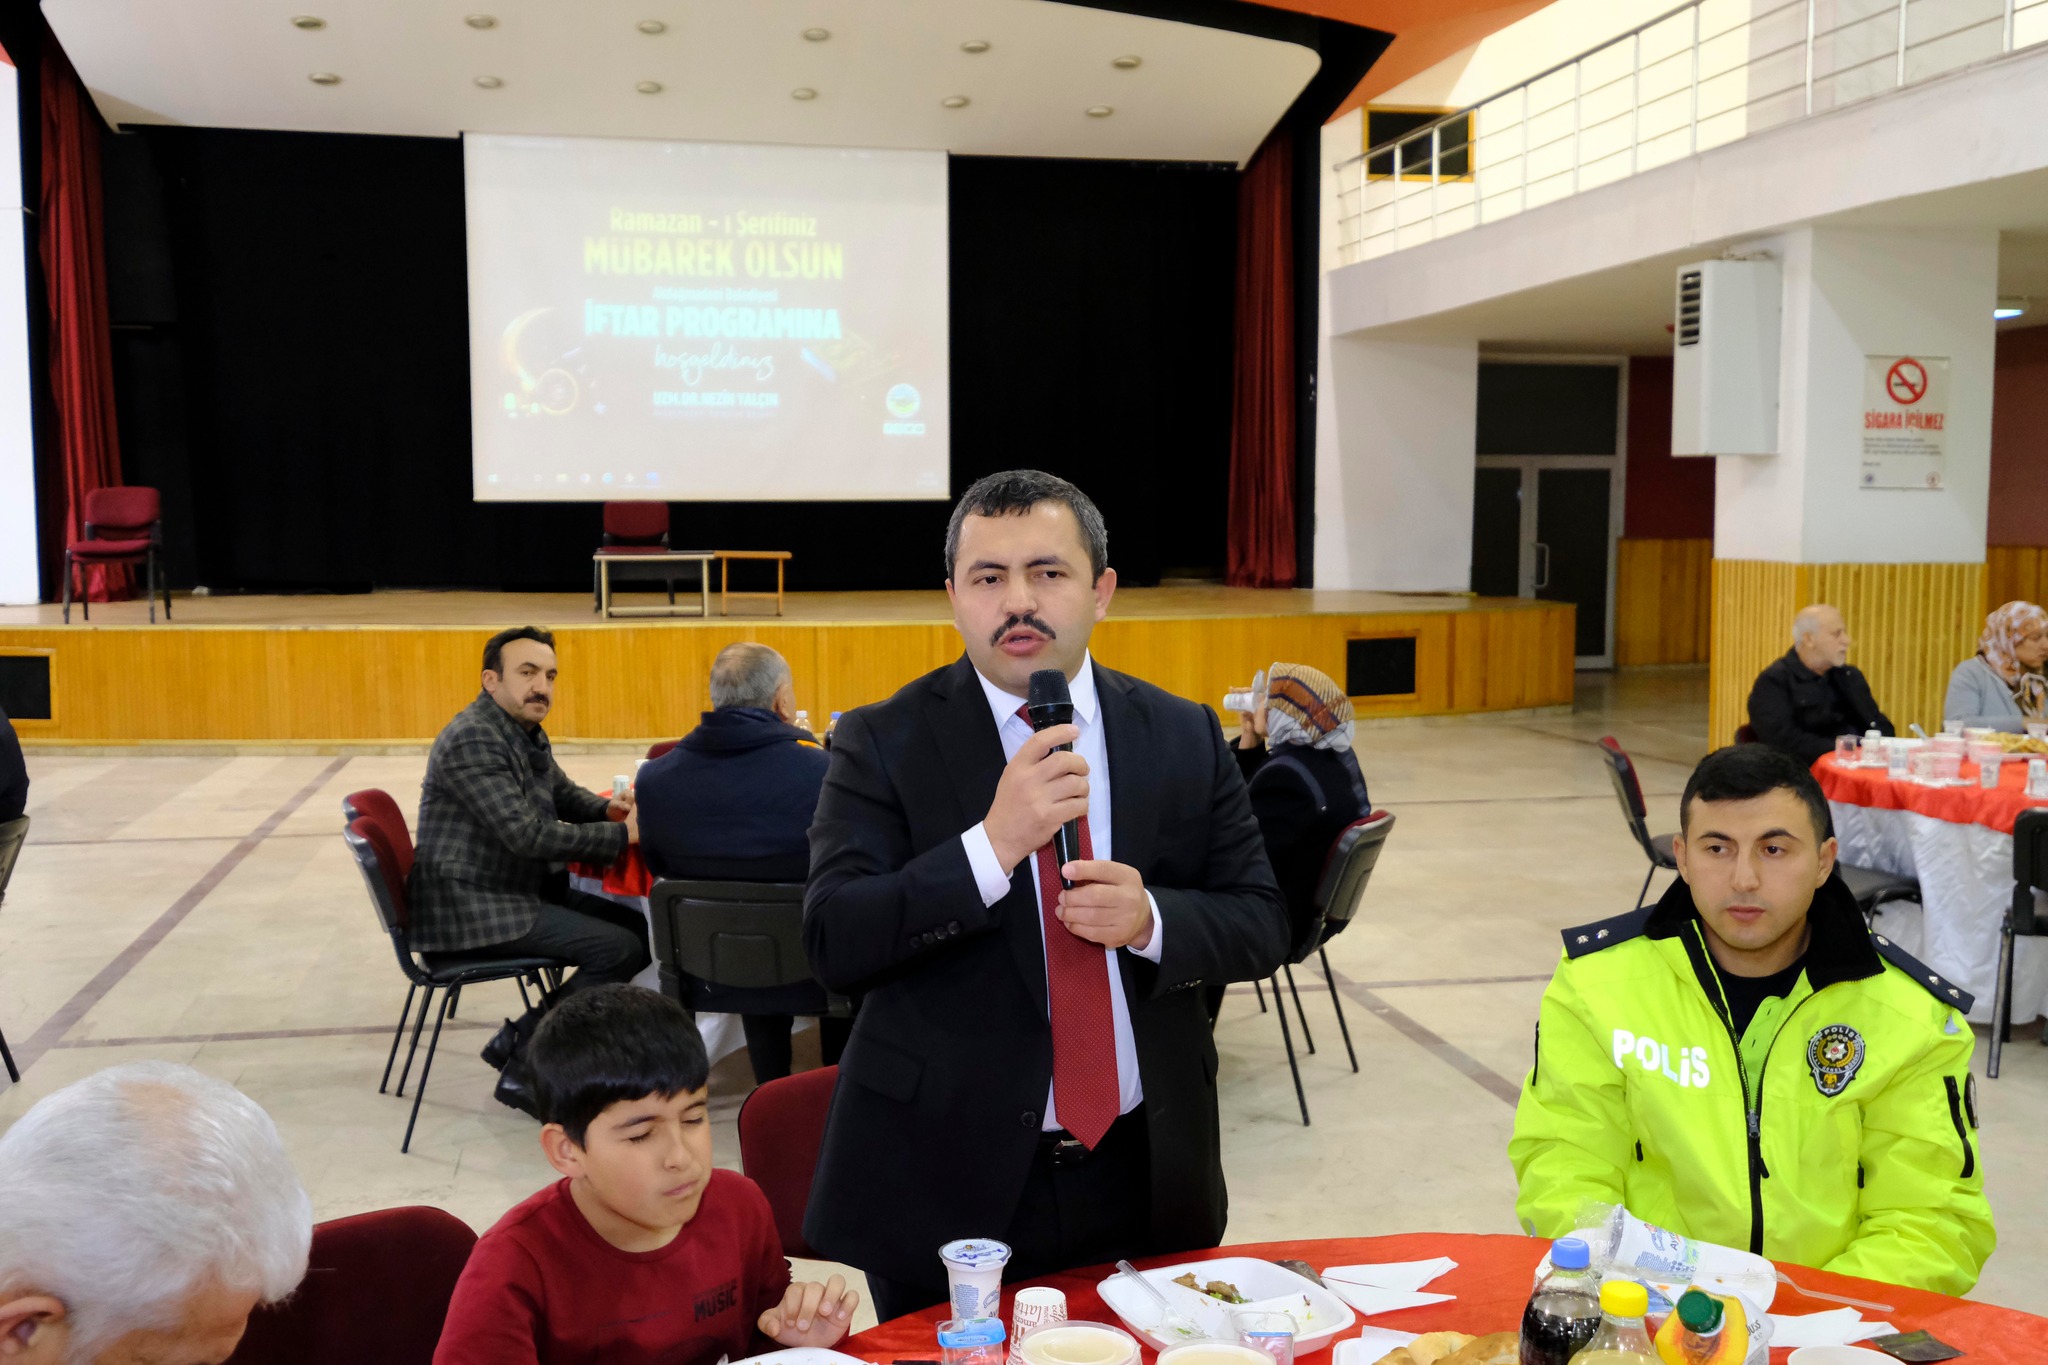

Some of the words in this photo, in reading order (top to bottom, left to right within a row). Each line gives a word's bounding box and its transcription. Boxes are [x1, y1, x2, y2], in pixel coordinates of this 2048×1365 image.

[610, 207, 701, 233] Ramazan
[737, 211, 817, 238] Şerifiniz
[584, 237, 735, 276] MÜBAREK
[745, 241, 844, 280] OLSUN
[585, 298, 660, 336] İFTAR
[666, 306, 842, 340] PROGRAMINA
[653, 341, 774, 386] hoşgeldiniz
[1864, 408, 1903, 430] SİGARA
[1905, 408, 1945, 432] İÇİLMEZ
[1824, 1026, 1855, 1039] POLİS
[1613, 1029, 1710, 1089] POLİS
[693, 1286, 738, 1323] MUSIC
